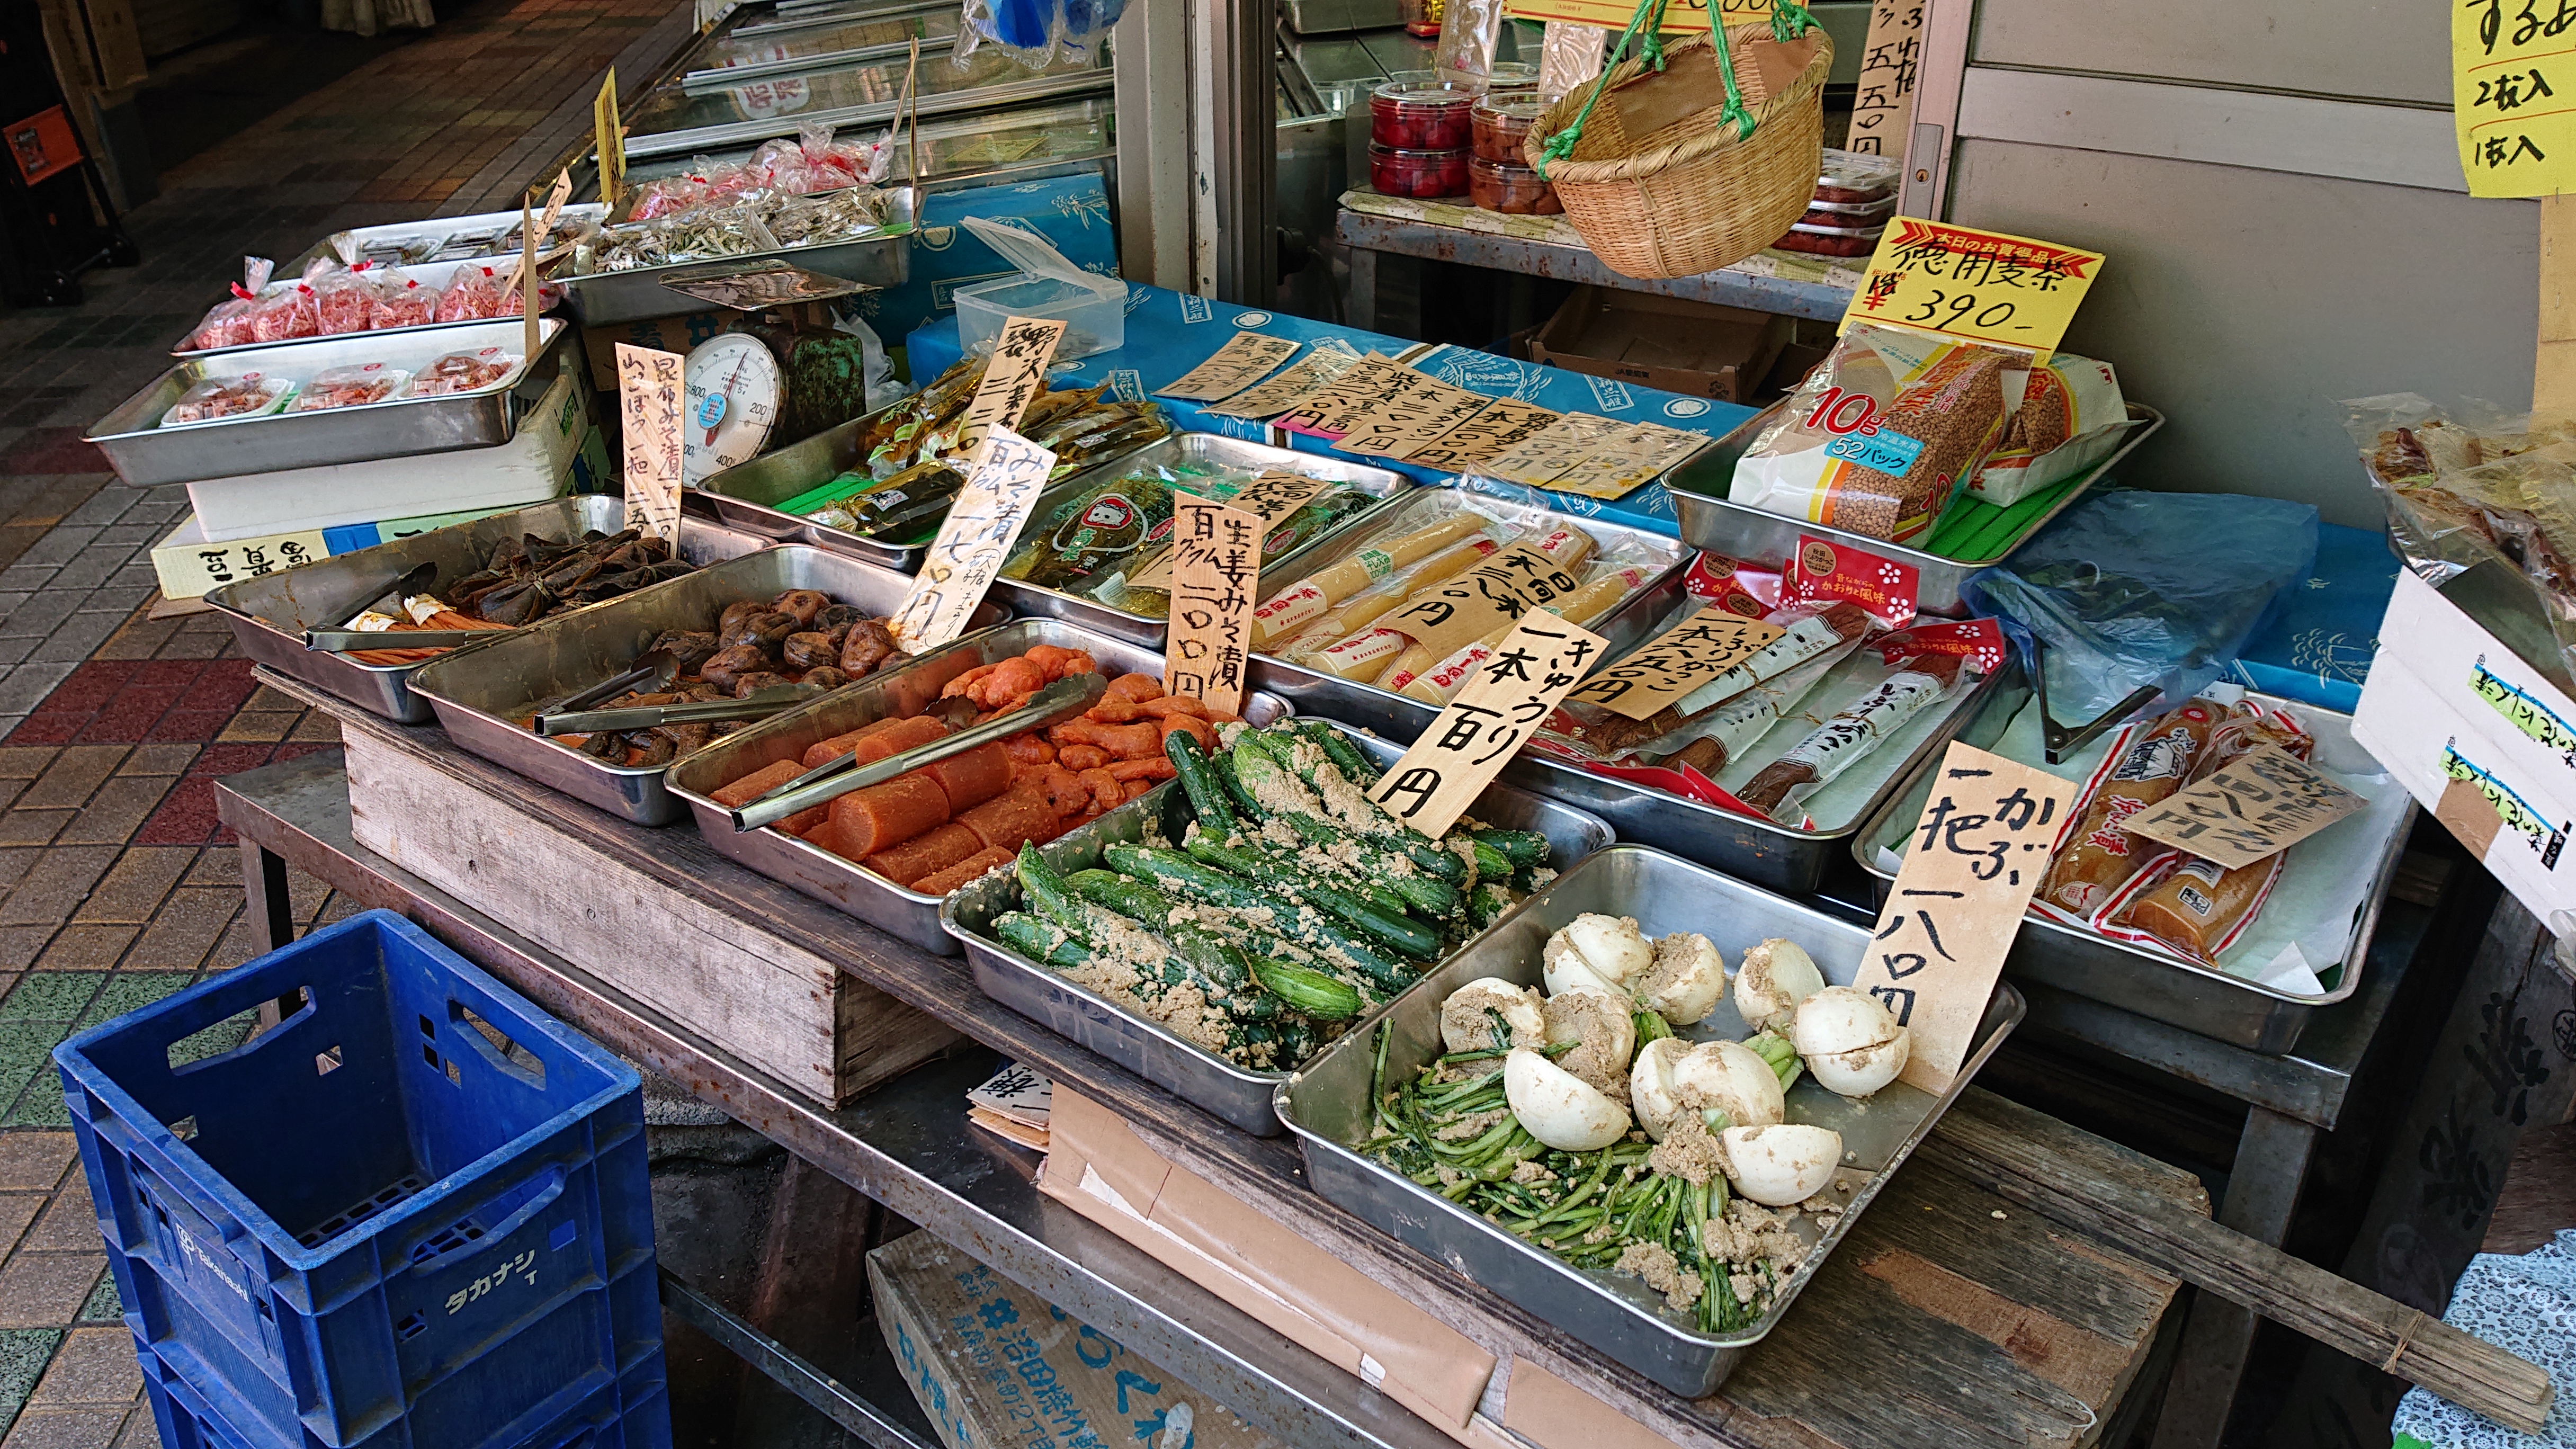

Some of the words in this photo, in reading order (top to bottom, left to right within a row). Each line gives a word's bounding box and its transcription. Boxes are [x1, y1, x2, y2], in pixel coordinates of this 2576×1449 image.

[1936, 232, 2049, 264] 本日のお買得品
[1804, 386, 1890, 437] 10g
[1832, 437, 1906, 468] 52パック
[978, 448, 1045, 546] みそ漬
[1056, 529, 1095, 561] 高菜
[1209, 518, 1256, 692] 生姜みそ漬
[1822, 582, 1886, 605] かおりと風味
[1836, 573, 1875, 589] 昔ながらの
[1472, 639, 1594, 766] きゅうり
[1972, 788, 2055, 886] かぶ
[194, 1242, 249, 1304] Takanashi
[444, 1248, 536, 1316] タカナシ
